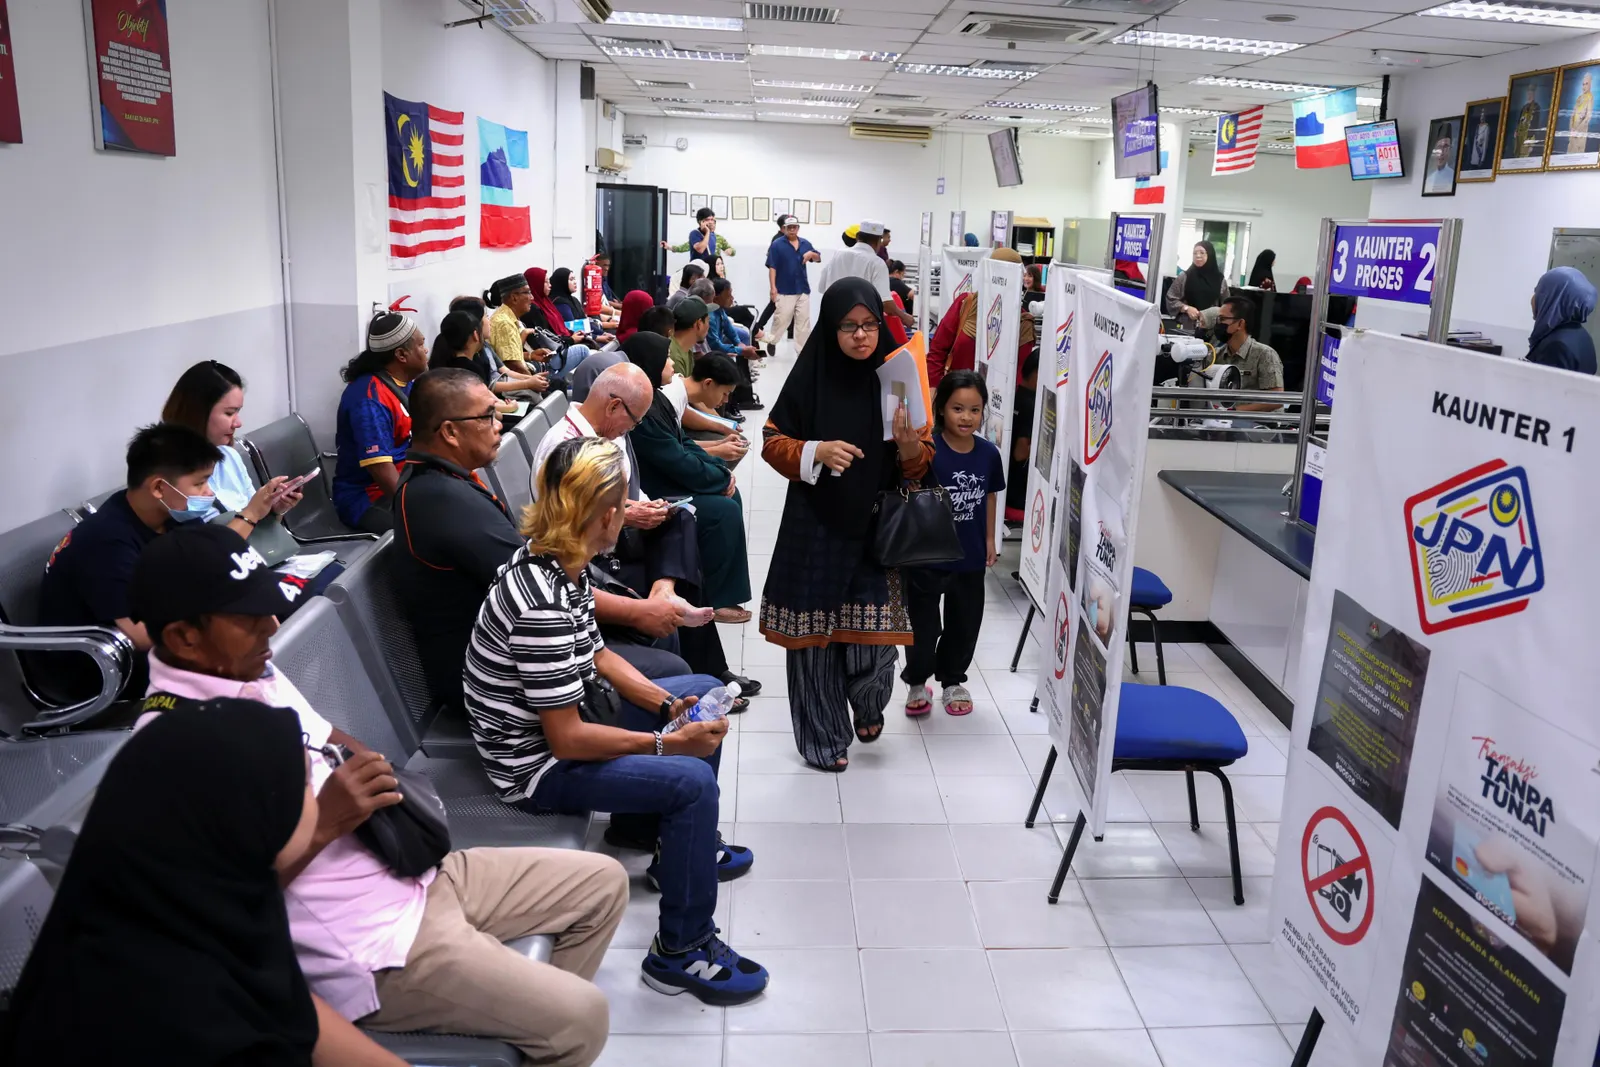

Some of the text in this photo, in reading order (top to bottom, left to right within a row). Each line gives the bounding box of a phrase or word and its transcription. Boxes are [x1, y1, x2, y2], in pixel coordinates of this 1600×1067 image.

[1379, 147, 1397, 160] A011
[1388, 161, 1393, 172] 6
[1115, 227, 1122, 253] 5
[1124, 224, 1146, 239] KAUNTER
[1124, 240, 1143, 257] PROSES
[1333, 240, 1349, 283] 3
[1354, 236, 1414, 261] KAUNTER
[1354, 264, 1404, 291] PROSES
[1414, 242, 1436, 292] 2
[1094, 312, 1126, 342] KAUNTER 2
[1088, 388, 1112, 426] JPN
[1432, 390, 1576, 453] KAUNTER 1
[953, 500, 976, 512] Day
[1414, 511, 1534, 589] JPN
[1390, 668, 1412, 688] Negara
[1349, 686, 1380, 716] pendaftaran
[1374, 683, 1389, 697] atau
[1389, 691, 1410, 712] WAKIL
[1382, 700, 1404, 720] urusan
[1472, 736, 1539, 782] Transaksi
[1485, 756, 1556, 823] TANPA
[1481, 775, 1547, 838] TUNAI
[1284, 917, 1360, 1015] MEMBUAT RAKAMAN VIDEO
[1307, 932, 1336, 972] DILARANG
[1432, 906, 1541, 1004] NOTIS KEPADA PELANGGAN
[1281, 928, 1356, 1025] ATAU MENGAMBIL GAMBAR
[1429, 1012, 1436, 1022] 2
